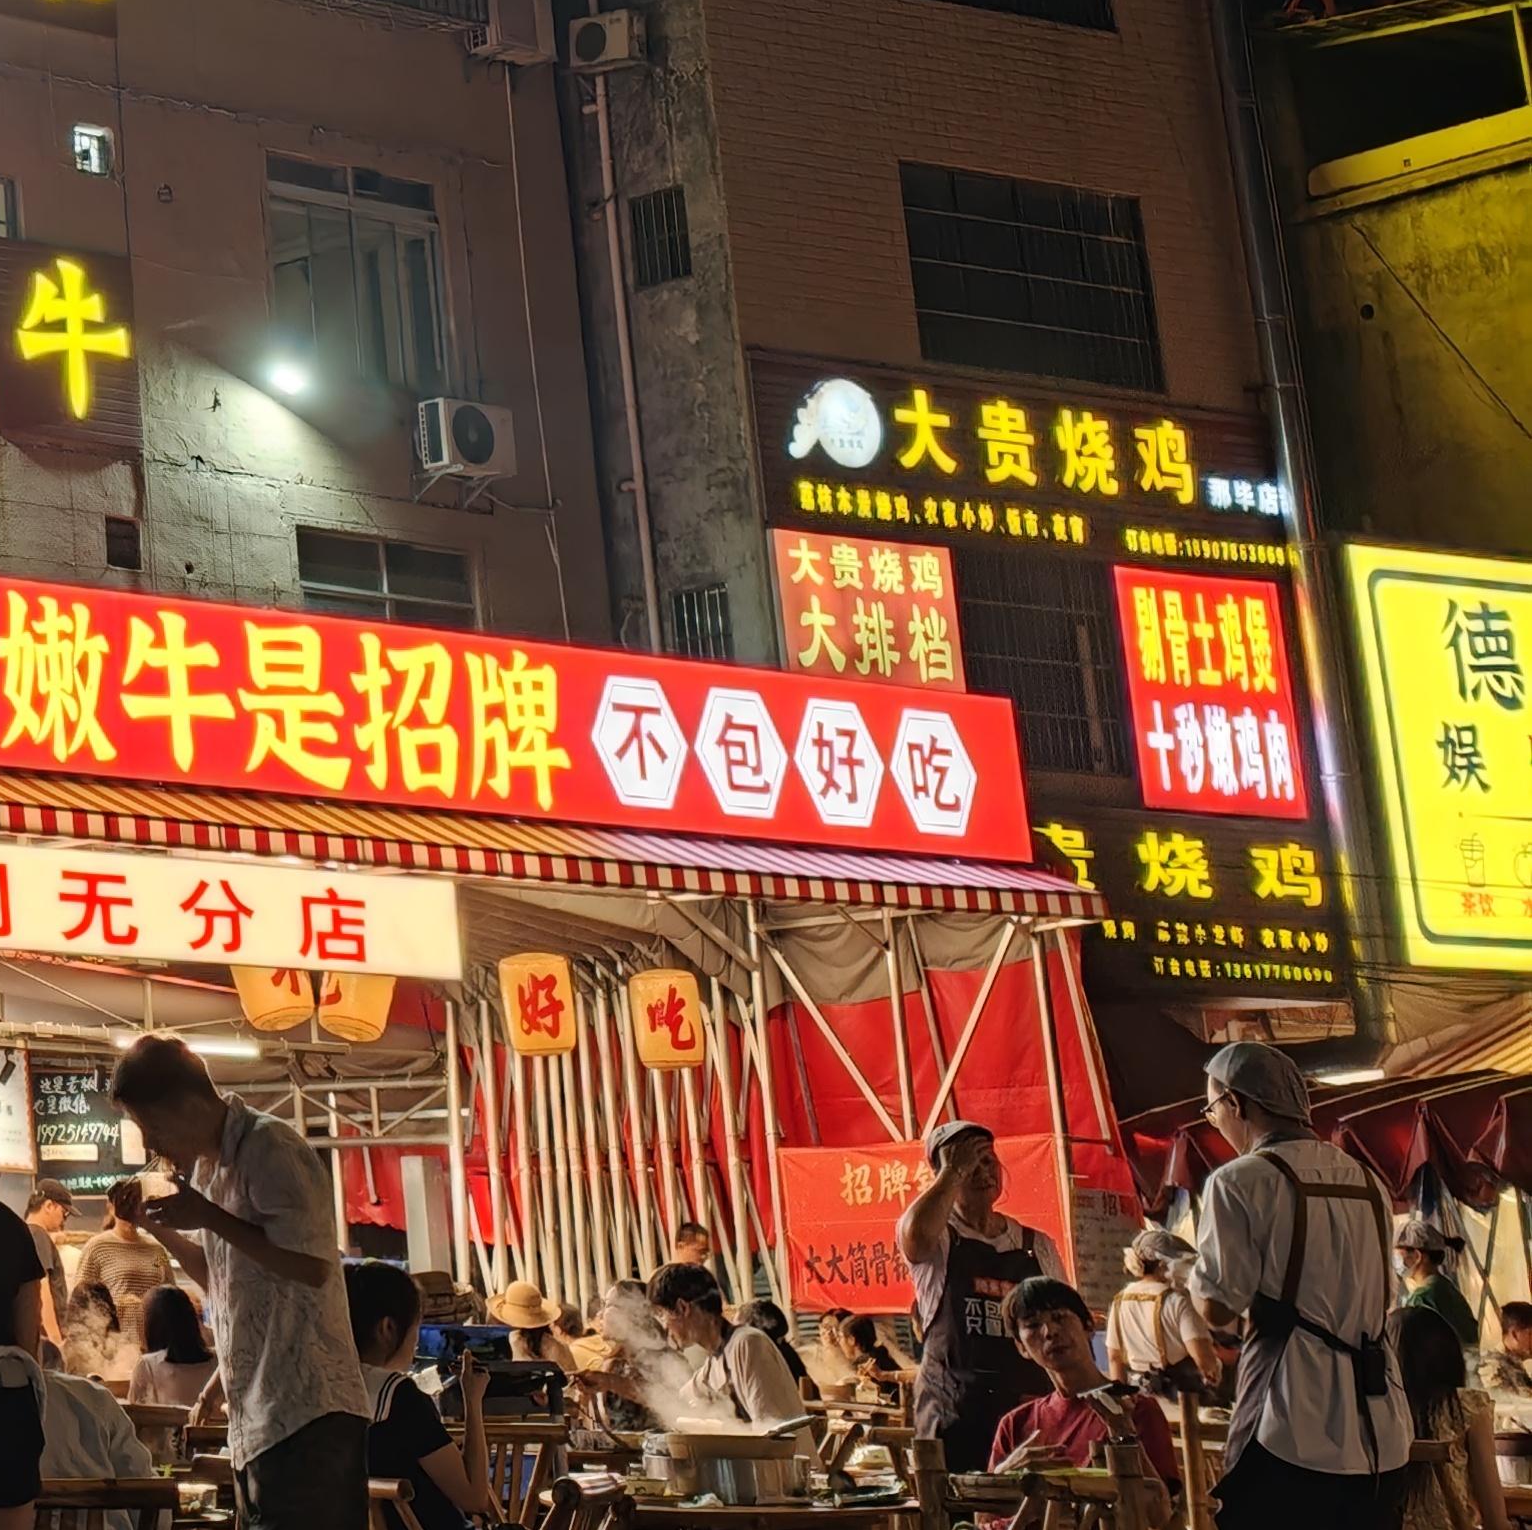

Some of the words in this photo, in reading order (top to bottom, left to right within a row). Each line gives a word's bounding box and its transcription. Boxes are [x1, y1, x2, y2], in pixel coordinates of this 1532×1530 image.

[893, 387, 1195, 506] 大贵烧鸡
[1207, 476, 1294, 517] 那毕店
[788, 538, 944, 600] 大贵烧鸡
[798, 593, 954, 684] 大排档
[1441, 597, 1525, 712] 德
[610, 702, 962, 813] 不包好吃
[1146, 700, 1296, 802] 十秒嫩鸡肉
[517, 972, 566, 1040] 好
[645, 985, 697, 1051] 吃
